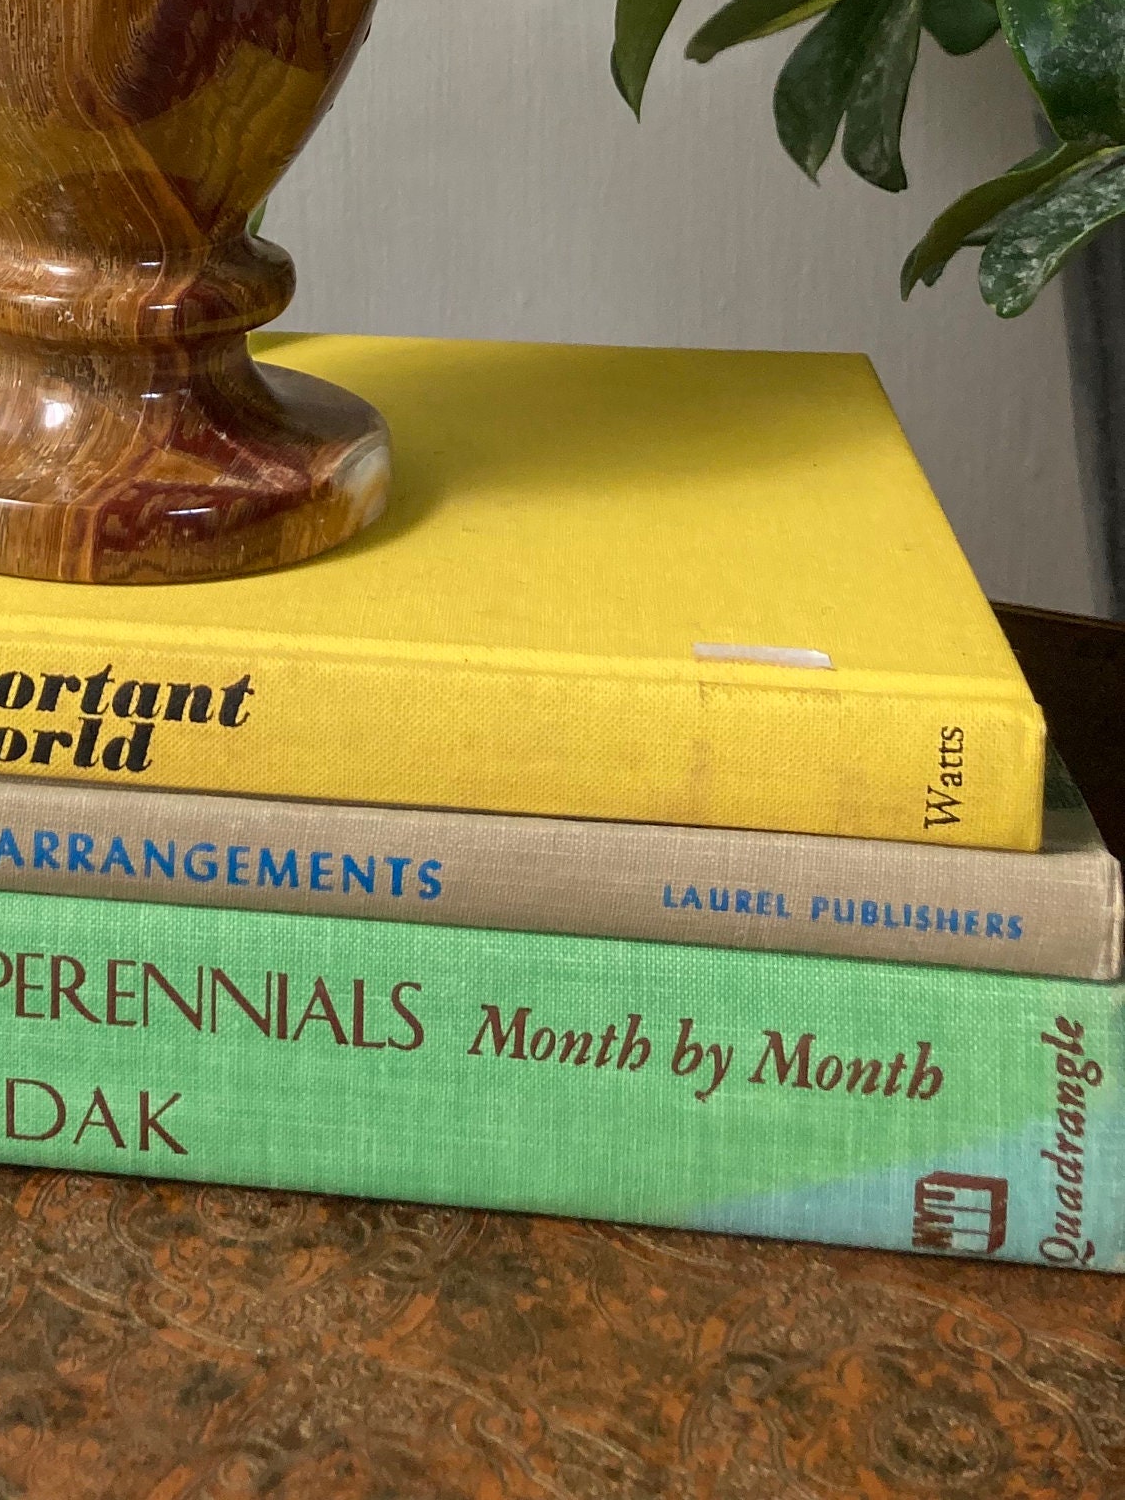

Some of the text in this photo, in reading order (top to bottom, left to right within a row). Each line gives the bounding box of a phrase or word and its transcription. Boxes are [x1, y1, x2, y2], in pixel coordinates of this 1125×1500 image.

[922, 724, 965, 830] Watts
[662, 884, 1025, 942] LAUREL PUBLISHERS
[466, 1004, 653, 1071] Month
[671, 1018, 734, 1102] by
[747, 1029, 945, 1102] Month
[1038, 1014, 1104, 1267] Quadrangle
